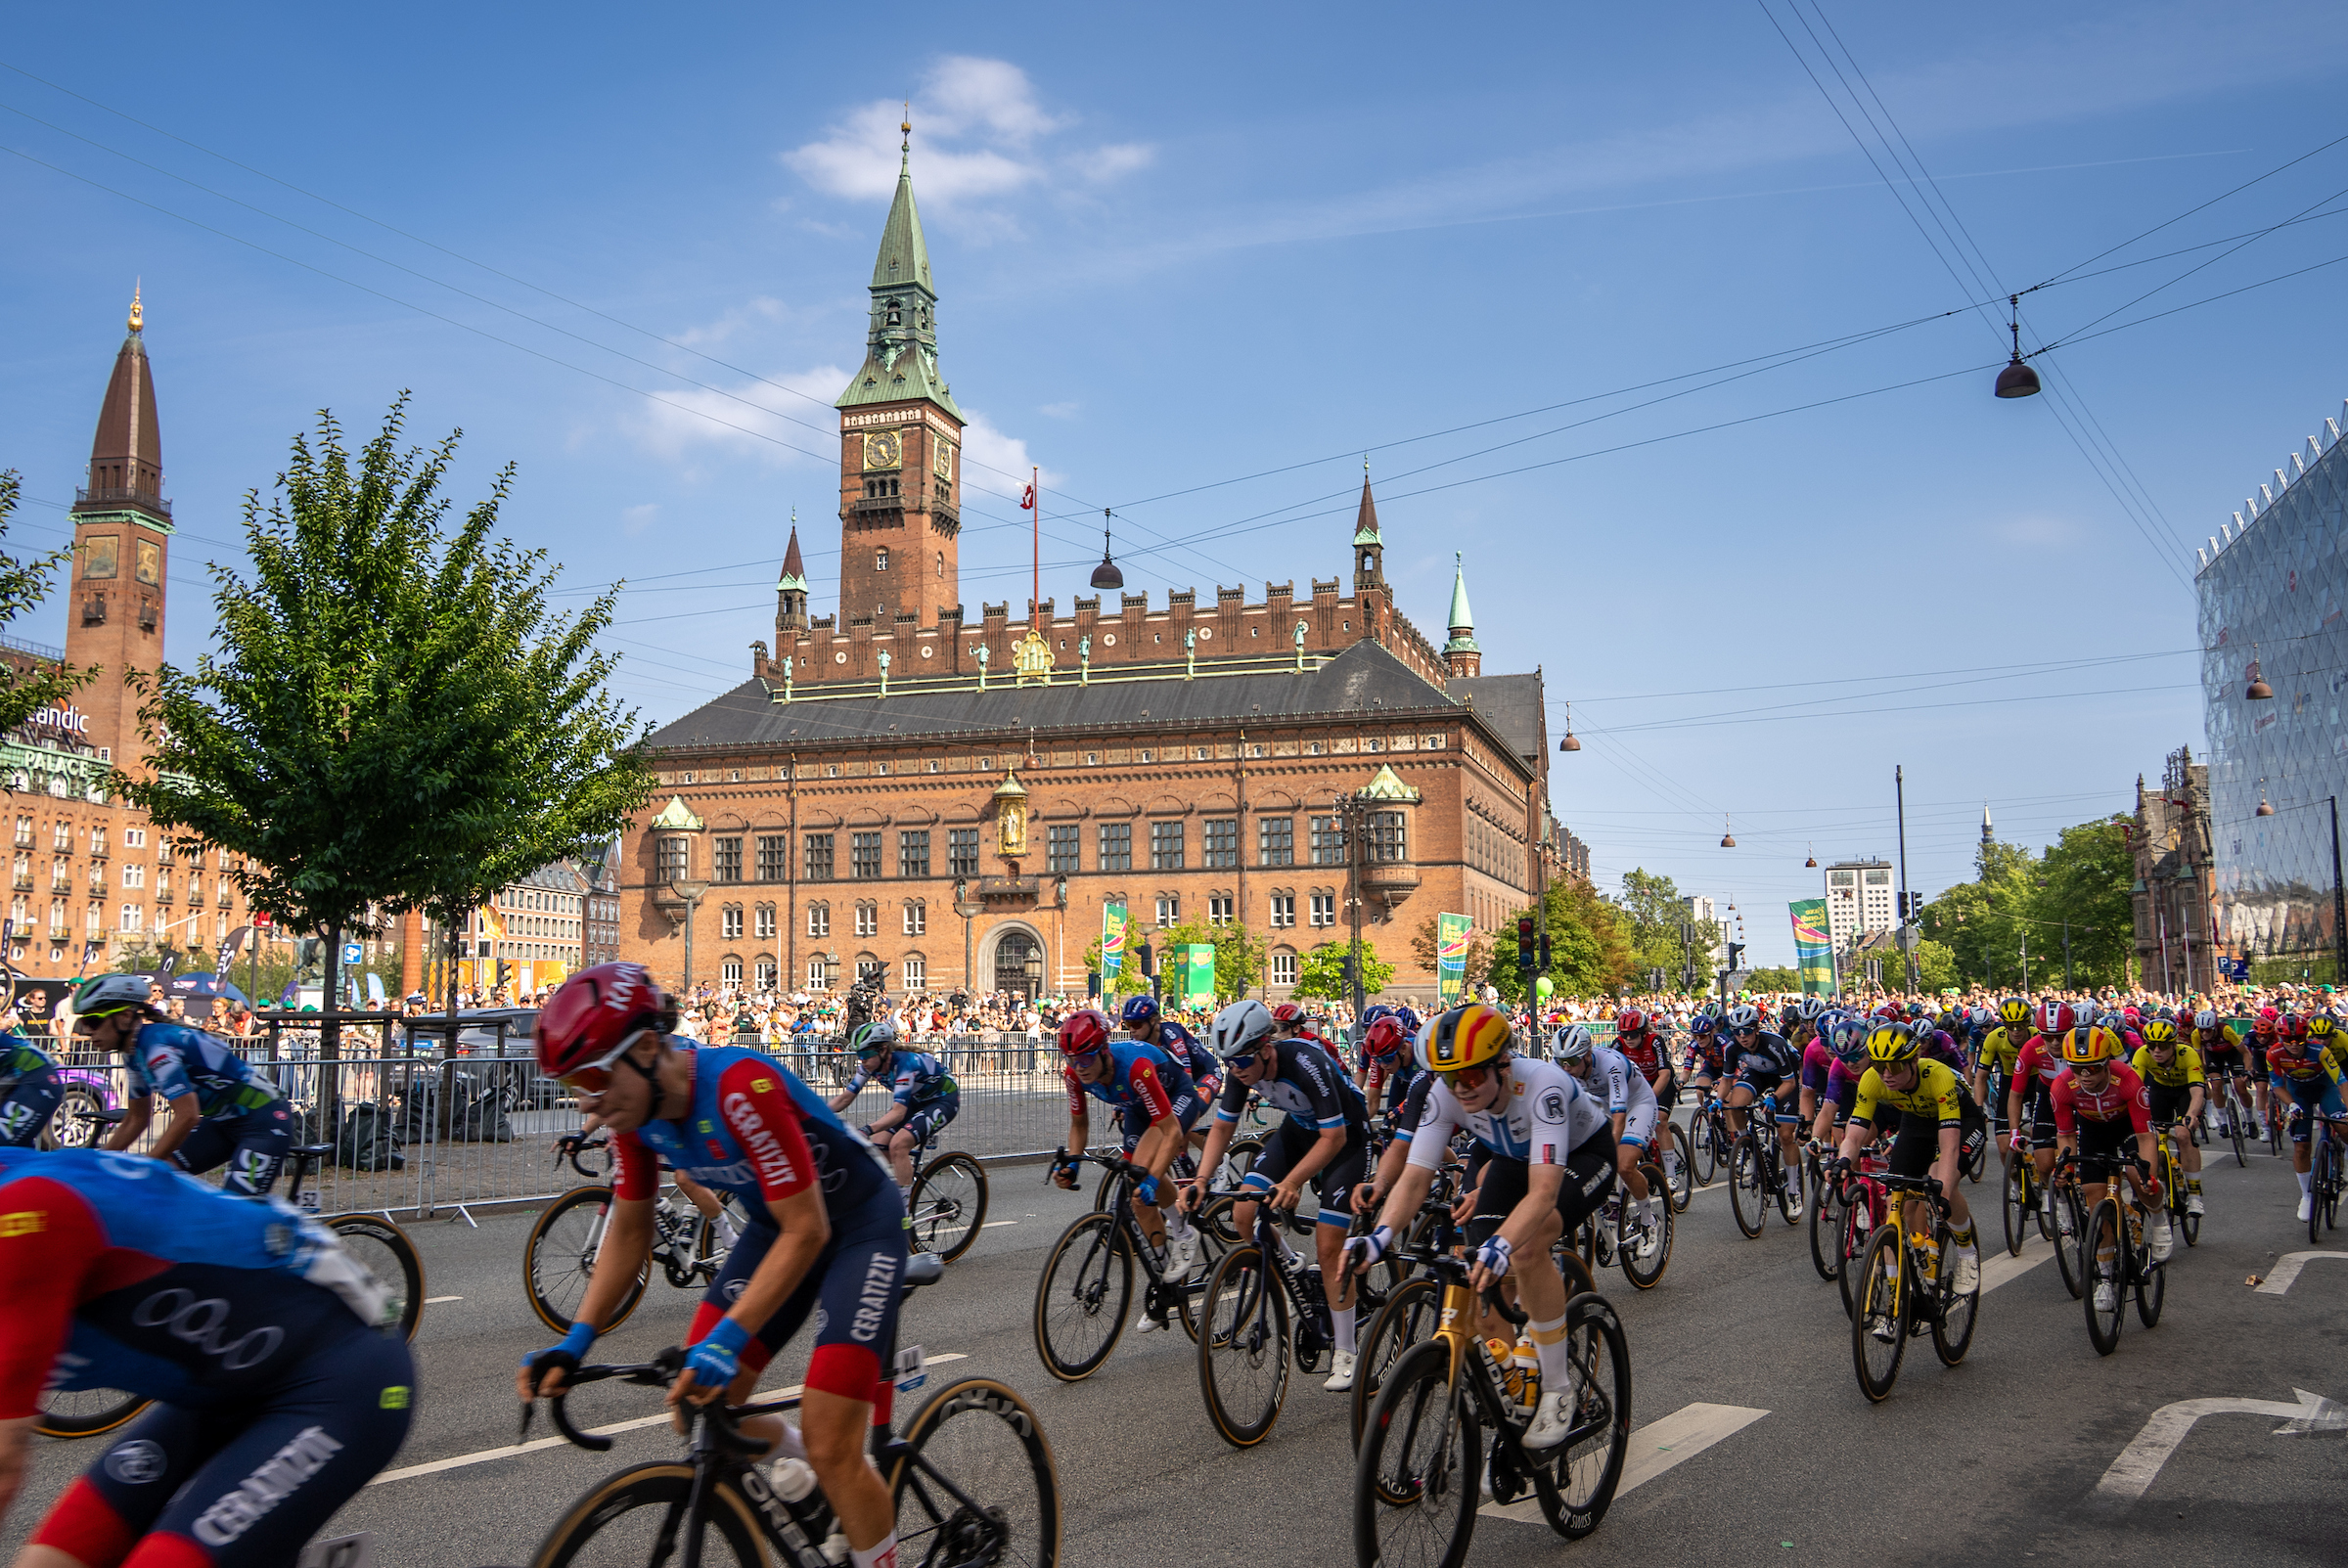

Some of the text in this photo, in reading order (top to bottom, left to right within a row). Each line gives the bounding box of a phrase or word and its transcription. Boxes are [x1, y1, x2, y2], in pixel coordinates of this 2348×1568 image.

[26, 704, 90, 733] andic
[24, 750, 89, 779] PALACE
[2220, 958, 2229, 967] P
[1132, 1078, 1162, 1117] CERATIZIT
[1611, 1075, 1621, 1099] sdworx
[723, 1092, 798, 1187] CERATIZIT
[302, 1191, 318, 1207] 52
[1130, 1221, 1163, 1276] ORBE
[849, 1251, 899, 1342] CERATIZIT
[1471, 1333, 1528, 1427] RIDLEY
[741, 1470, 830, 1568] ORBE
[1569, 1510, 1592, 1530] SWISS
